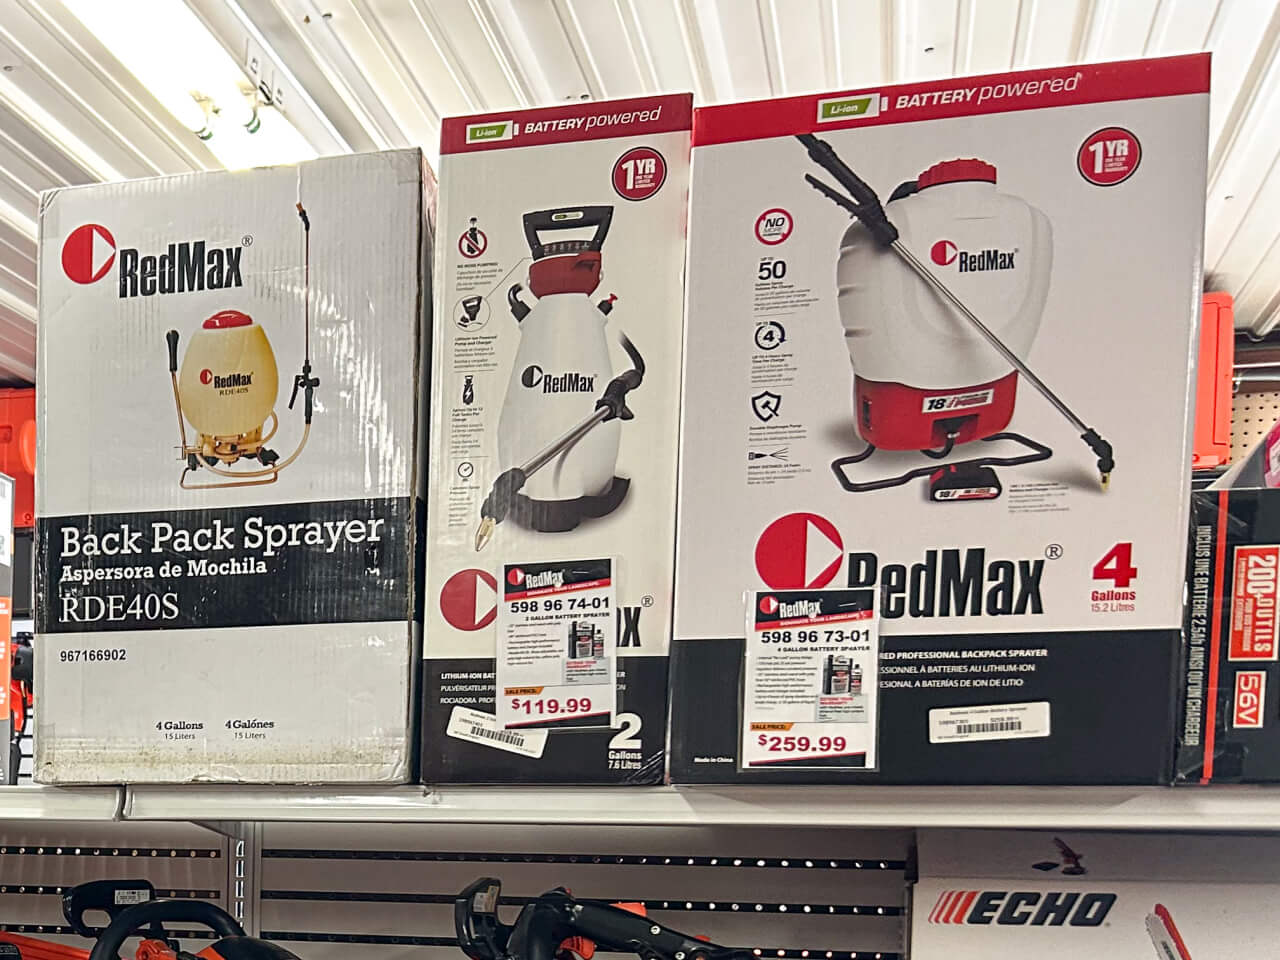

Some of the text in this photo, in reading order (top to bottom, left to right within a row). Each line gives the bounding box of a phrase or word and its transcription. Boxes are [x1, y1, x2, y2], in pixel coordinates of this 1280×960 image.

[895, 87, 975, 110] BATTERY
[978, 74, 1079, 105] powered
[525, 106, 661, 134] BATTERY powered
[1105, 140, 1129, 157] YR
[636, 158, 656, 175] YR
[766, 218, 785, 228] NO
[120, 241, 242, 298] RedMax
[758, 260, 786, 280] 50
[960, 252, 1015, 273] RedMax
[214, 372, 252, 389] RedMax
[544, 372, 594, 393] RedMax
[928, 399, 946, 410] 18
[61, 517, 384, 557] Back Pack Sprayer
[1197, 526, 1211, 557] INCLUS
[61, 558, 267, 586] Aspersora de Mochila
[1092, 542, 1137, 587] 4
[1195, 558, 1209, 574] UNE
[526, 570, 564, 588] RedMax
[1091, 590, 1136, 601] Gallons
[1192, 577, 1209, 617] BATTERIE
[60, 592, 178, 623] RDE40S
[511, 597, 609, 613] 598 96 74-01
[779, 600, 821, 618] RedMax
[761, 630, 869, 643] 598 96 73-01
[60, 649, 126, 662] 967166902
[898, 649, 1047, 660] PROFESSIONAL BACKPACK SPRAYER
[927, 664, 1035, 673] BATTERIES LITHIUM-ION
[922, 677, 1023, 688] BATERÍAS ION LITIO
[512, 698, 592, 715] $119.99
[1240, 675, 1258, 724] 56V
[156, 720, 203, 730] 4 Gallons
[225, 721, 232, 729] 4
[609, 713, 642, 749] 2
[758, 735, 846, 751] $259.99
[609, 751, 642, 760] Gallons
[967, 892, 1117, 926] ECHO
